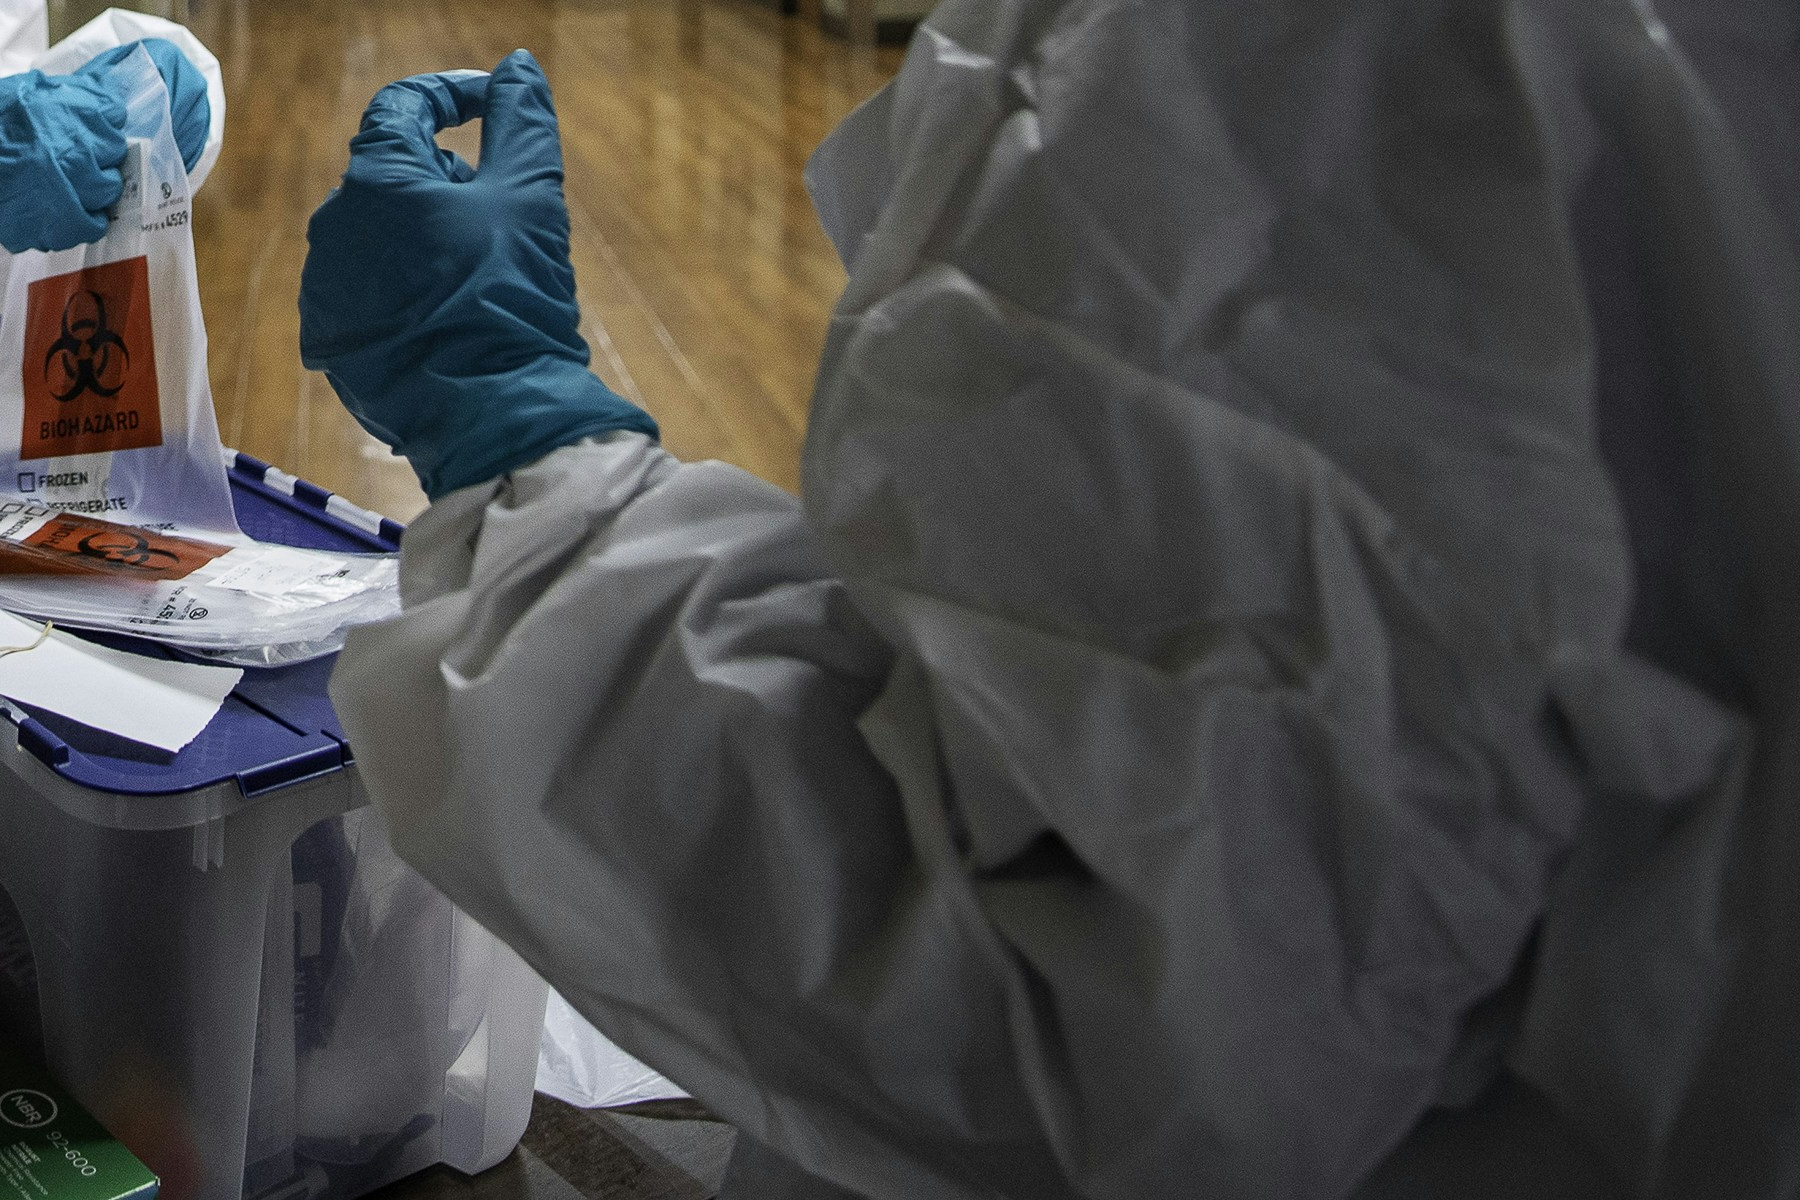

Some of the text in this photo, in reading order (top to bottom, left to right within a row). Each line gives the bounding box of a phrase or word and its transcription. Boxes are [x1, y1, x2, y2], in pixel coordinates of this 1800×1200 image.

[40, 410, 139, 440] BIOHAZARD
[38, 472, 89, 488] FROZEN
[11, 1094, 43, 1123] NBR
[45, 1131, 97, 1178] 92-600
